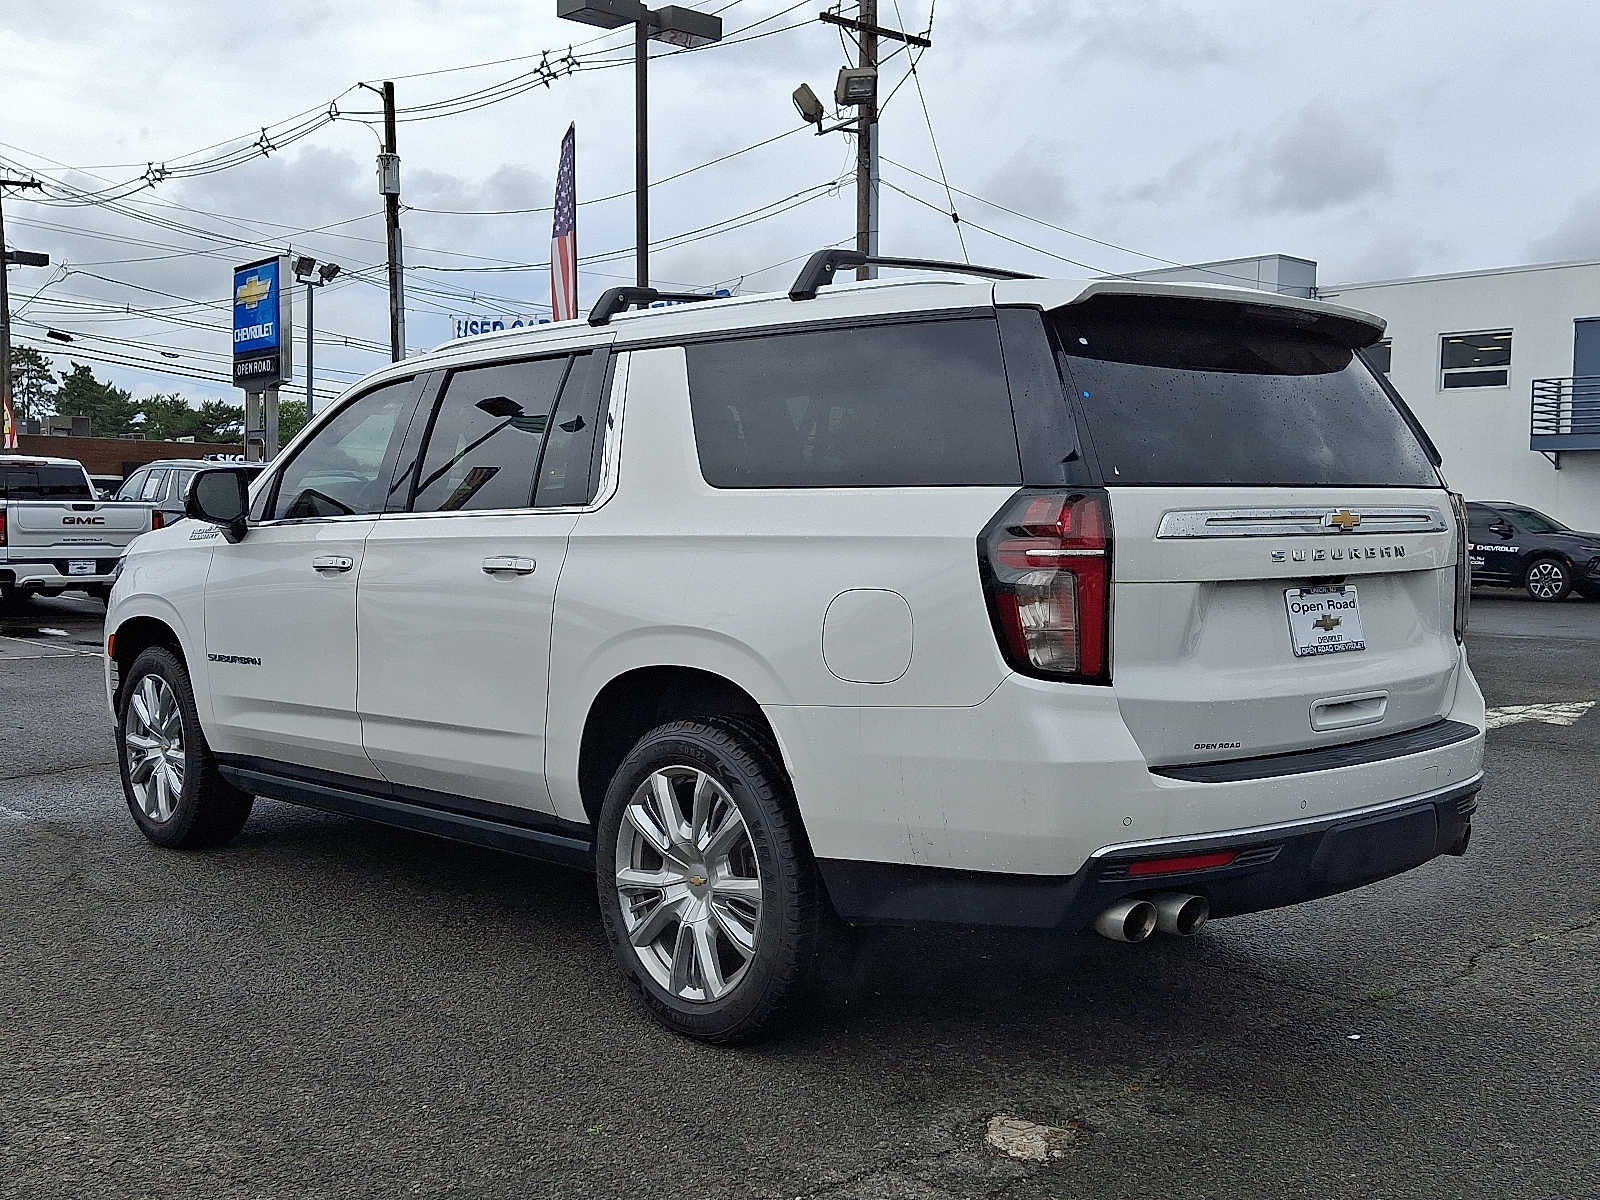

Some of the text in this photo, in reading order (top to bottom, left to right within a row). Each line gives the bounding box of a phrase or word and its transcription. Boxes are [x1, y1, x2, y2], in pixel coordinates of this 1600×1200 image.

[234, 321, 274, 343] CHEVROLET
[457, 320, 505, 338] USED
[236, 359, 271, 376] OPEN ROAD
[62, 516, 105, 525] GMC
[1270, 545, 1406, 562] SUBURBAN
[1476, 544, 1520, 553] CHEVROLET
[1290, 599, 1356, 615] Open Road
[207, 653, 262, 666] SUBURBAN
[1193, 741, 1241, 750] OPEN ROAD
